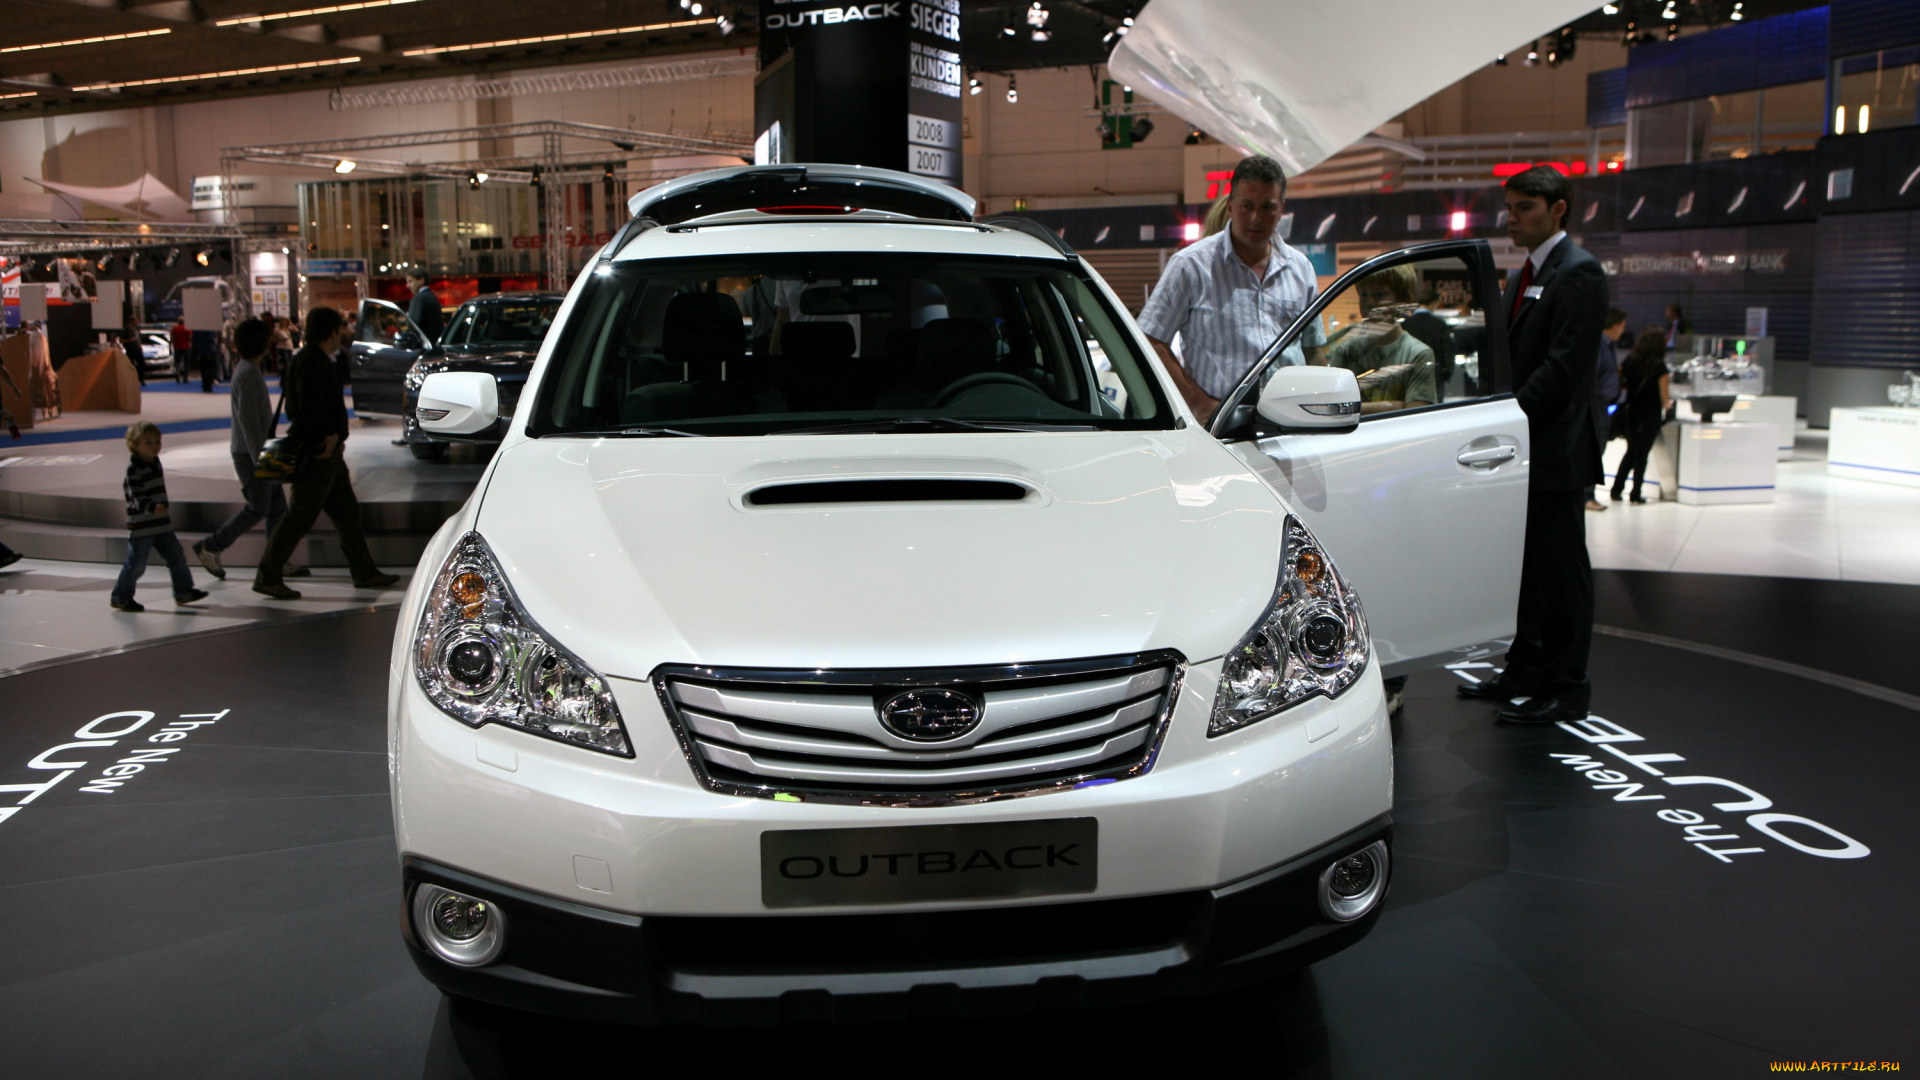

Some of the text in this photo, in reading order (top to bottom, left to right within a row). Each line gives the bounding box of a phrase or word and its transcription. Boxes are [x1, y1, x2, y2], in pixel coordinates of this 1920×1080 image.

[766, 2, 901, 29] OUTBACK
[910, 2, 960, 42] SIEGER
[910, 53, 961, 85] KUNDEN
[916, 120, 943, 142] 2008
[916, 151, 942, 172] 2007
[511, 231, 611, 249] GERAG
[0, 710, 156, 824] OUT
[78, 708, 231, 793] The New
[1549, 753, 1766, 863] The New
[779, 843, 1081, 880] OUTBACK
